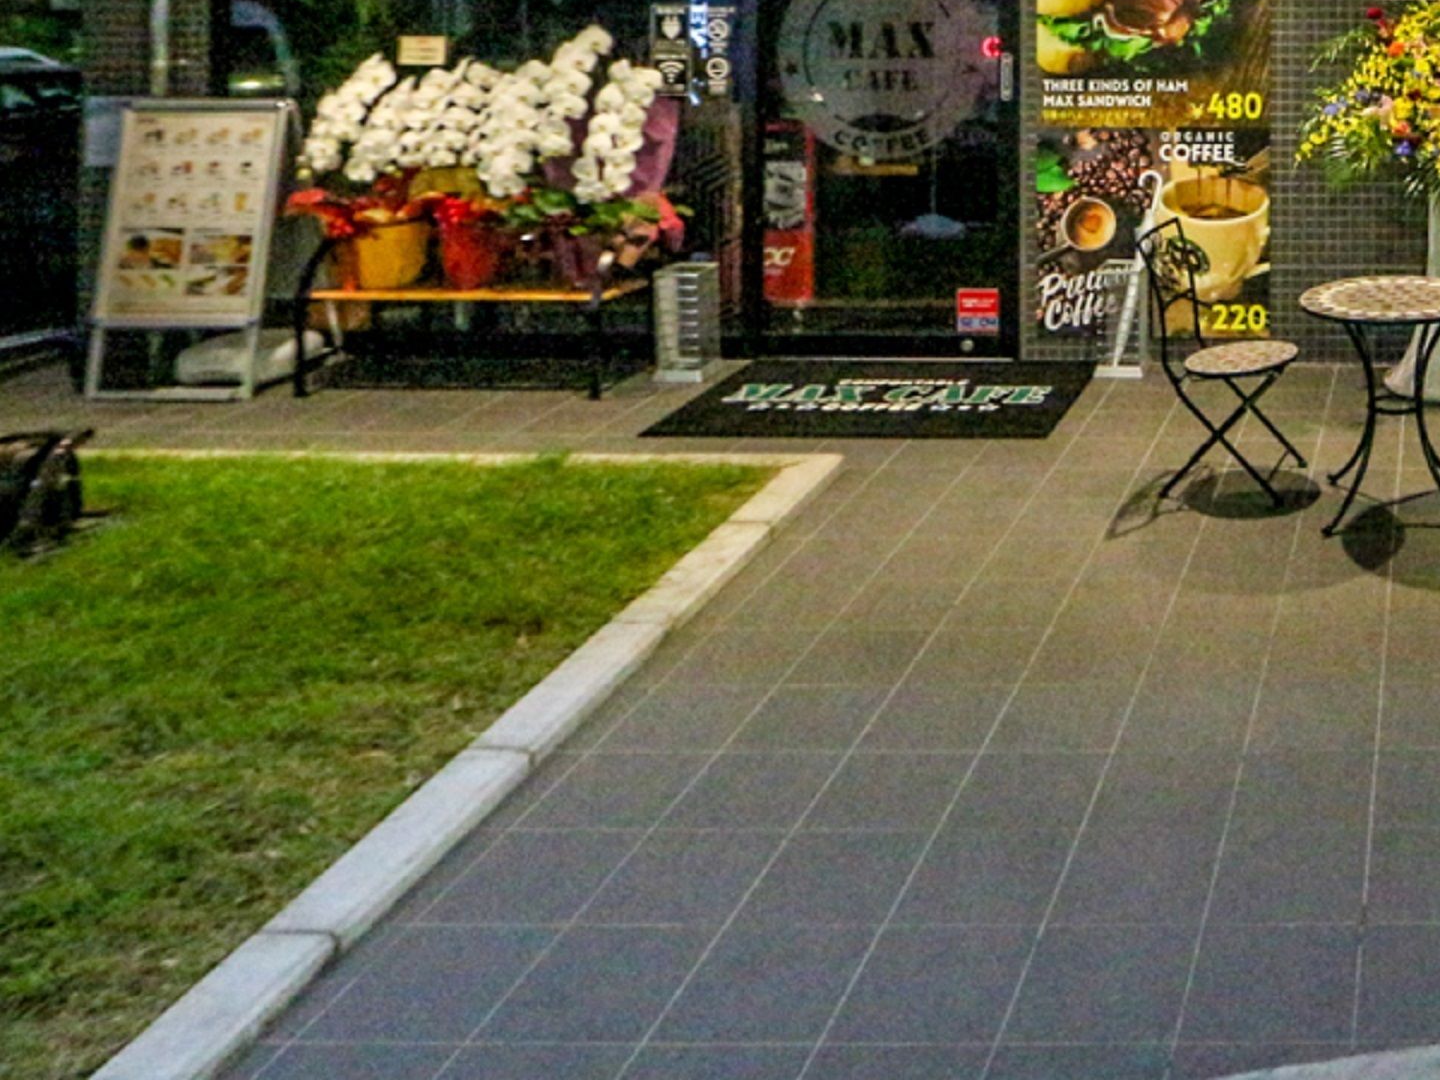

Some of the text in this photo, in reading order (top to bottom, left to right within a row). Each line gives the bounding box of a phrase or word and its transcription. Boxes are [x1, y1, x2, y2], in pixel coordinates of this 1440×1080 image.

[1042, 79, 1188, 92] THREE KINDS OF HAM
[1042, 94, 1151, 107] MAX SANDWICH
[1160, 131, 1235, 143] ORGANIC
[1159, 144, 1235, 162] COFFEE
[721, 383, 1053, 404] MAX CAFE
